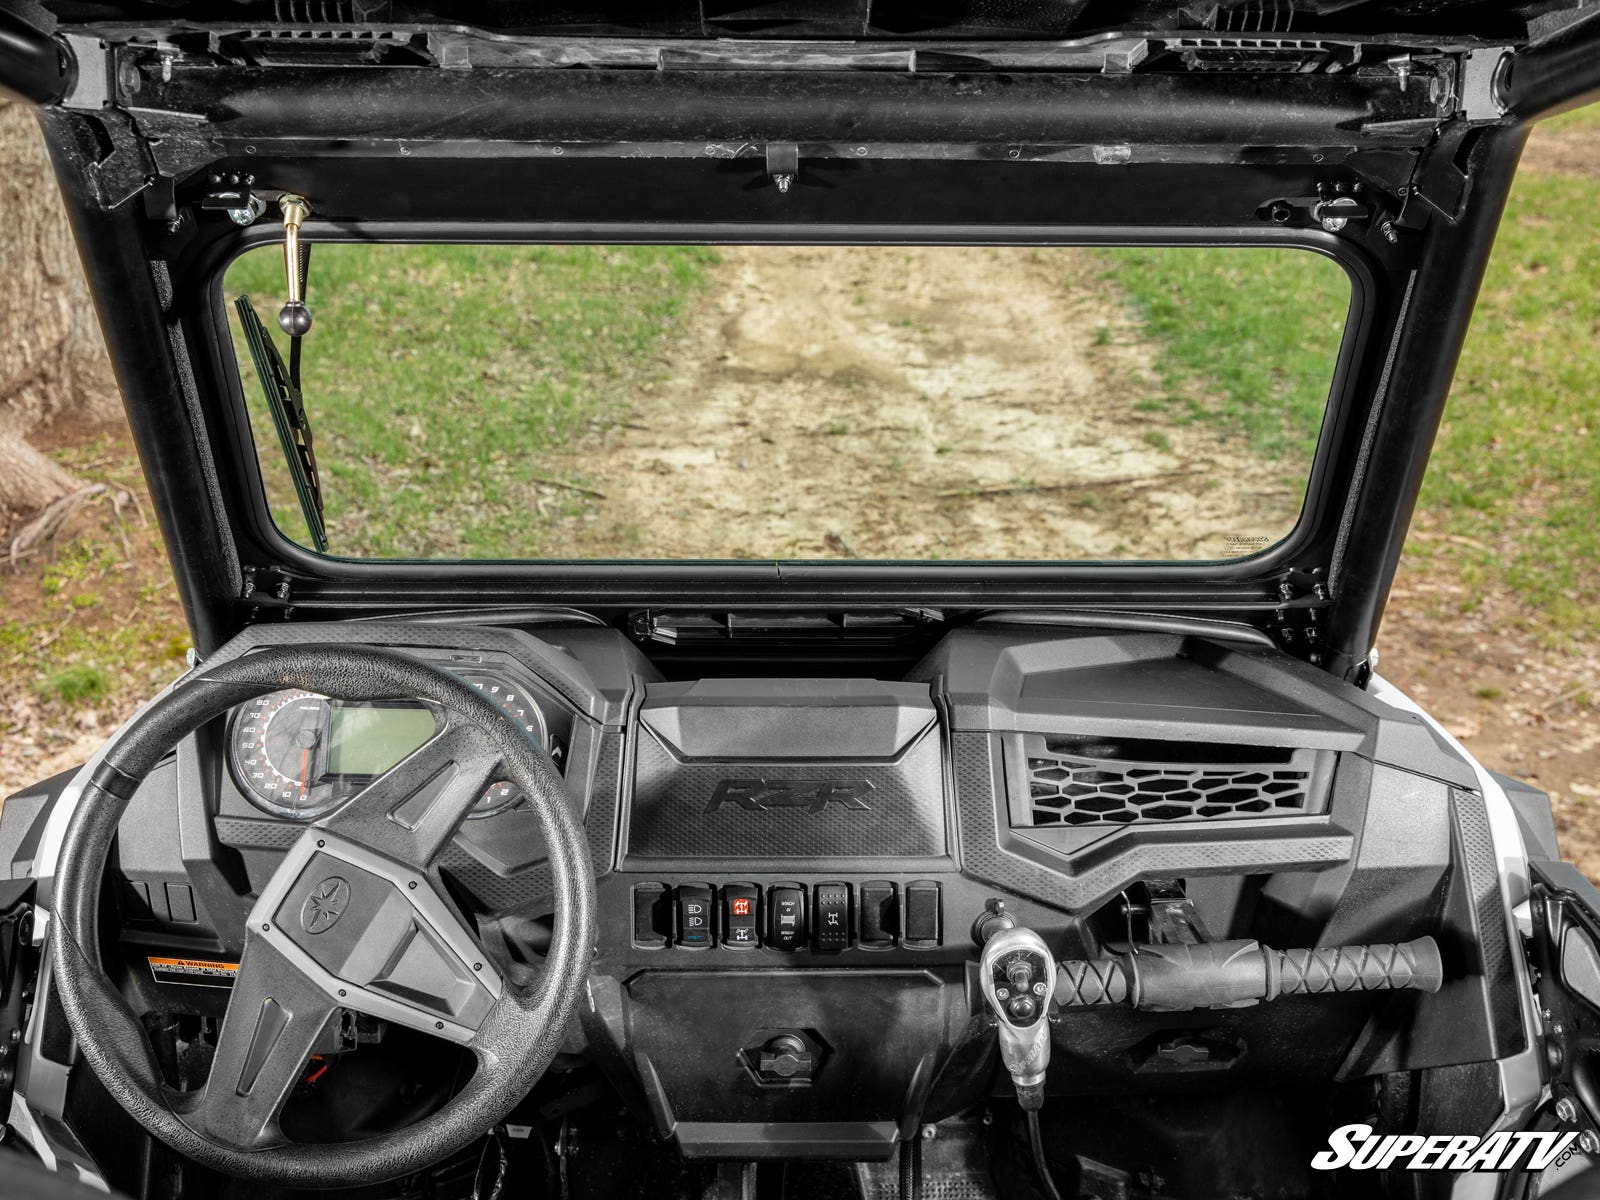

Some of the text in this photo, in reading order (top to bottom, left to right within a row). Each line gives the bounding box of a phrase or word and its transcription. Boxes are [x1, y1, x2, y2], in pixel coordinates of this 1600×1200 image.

[490, 686, 500, 694] 9
[506, 694, 515, 702] 8
[500, 788, 509, 796] 2
[702, 778, 876, 815] RZR
[186, 961, 225, 969] WARNING
